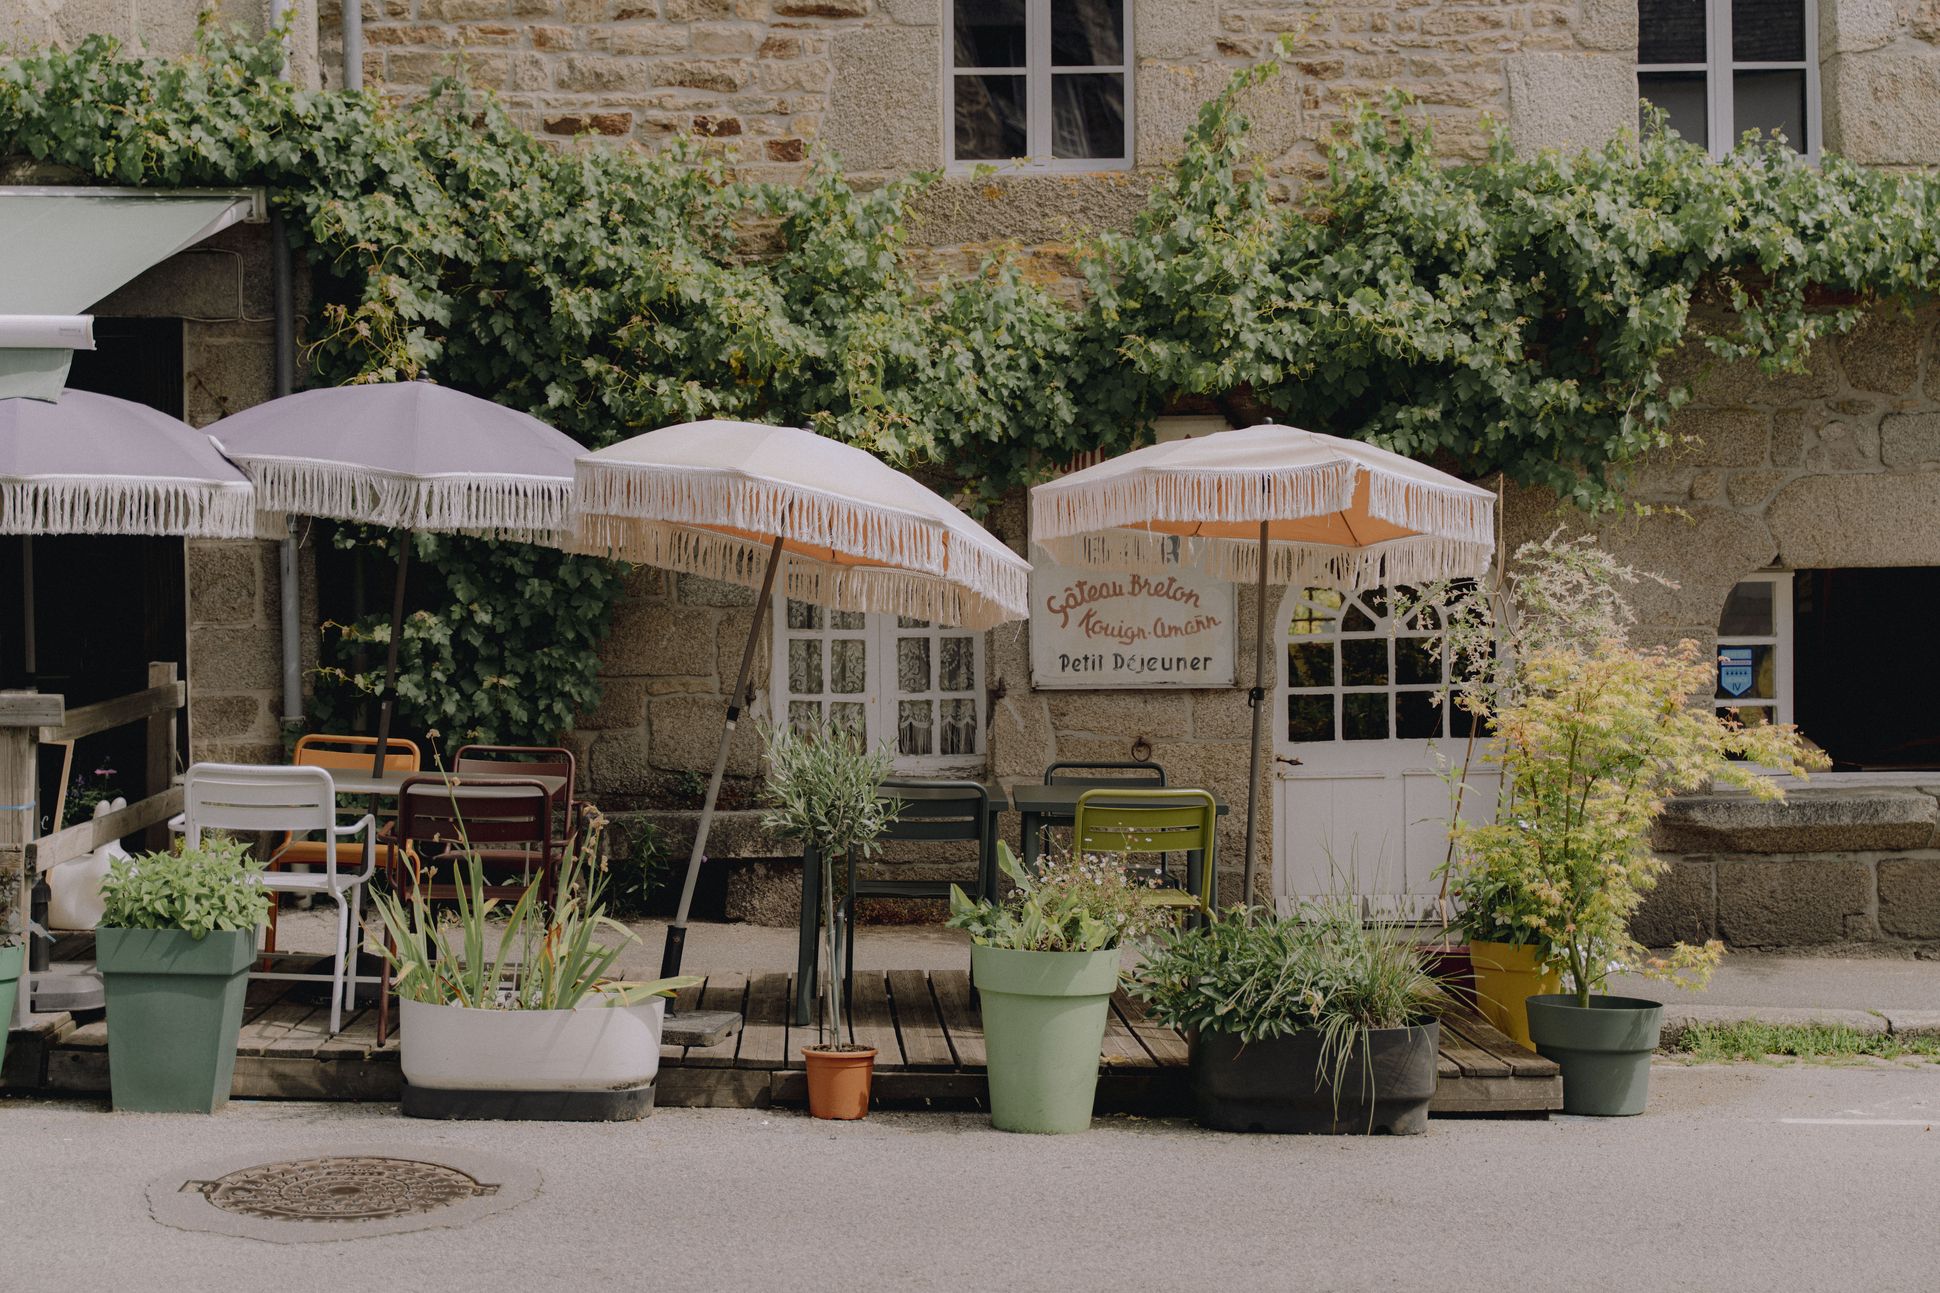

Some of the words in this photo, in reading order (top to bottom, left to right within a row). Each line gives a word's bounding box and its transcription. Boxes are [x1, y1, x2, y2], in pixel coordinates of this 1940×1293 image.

[1047, 580, 1124, 629] Gâteau
[1128, 574, 1200, 608] Breton
[1112, 652, 1213, 673] Déjeuner
